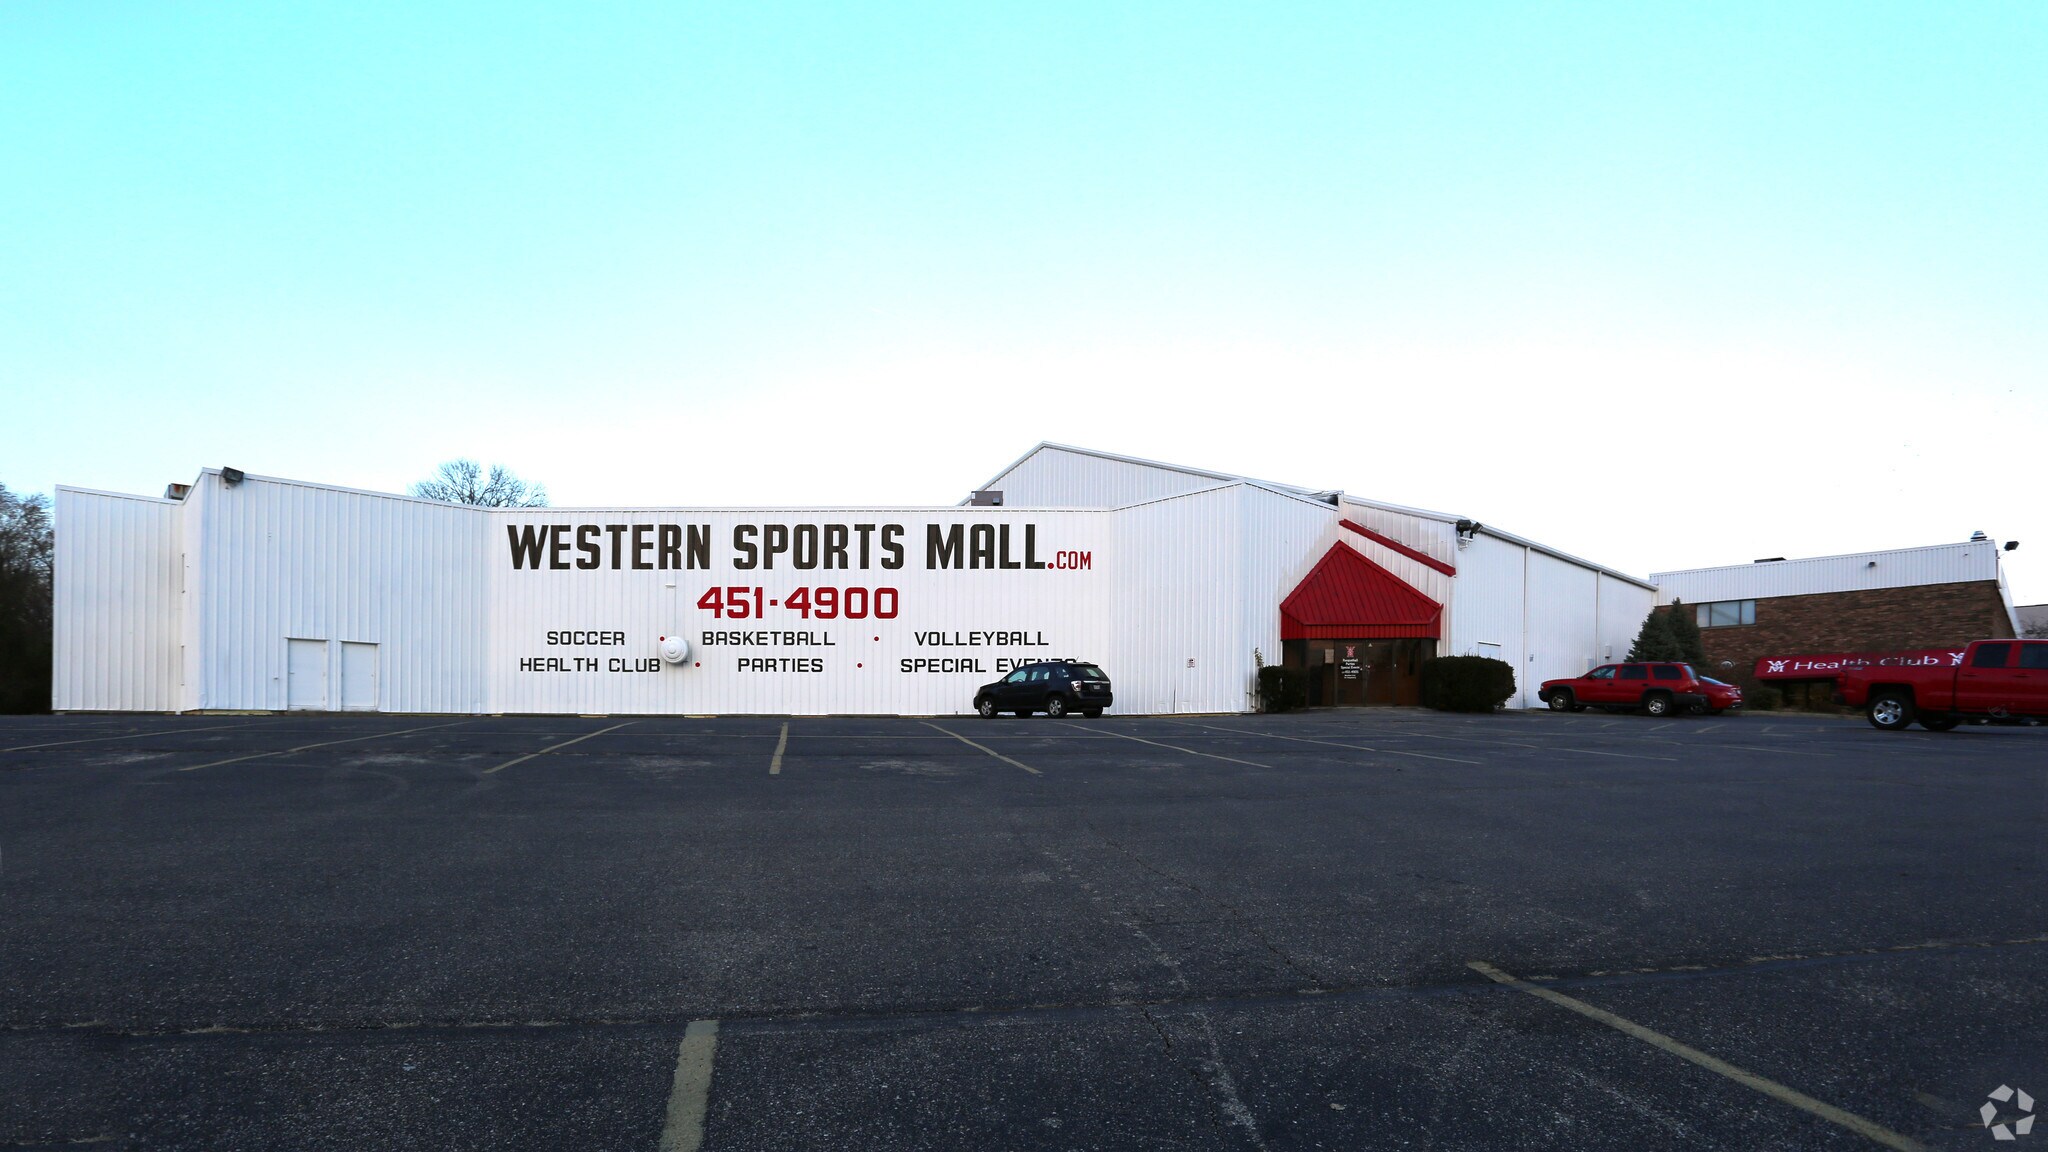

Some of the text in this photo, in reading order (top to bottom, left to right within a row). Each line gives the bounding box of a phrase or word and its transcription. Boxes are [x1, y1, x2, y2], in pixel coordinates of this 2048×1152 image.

[507, 524, 711, 570] WESTERN
[733, 523, 905, 570] SPORTS
[696, 586, 899, 620] 451-4900
[546, 631, 1049, 646] SOCCER BASKETBALL VOLLEYBALL
[520, 657, 598, 672] HEALTH
[608, 657, 661, 673] CLUB
[737, 658, 824, 673] PARTIES
[900, 658, 987, 673] SPECIAL
